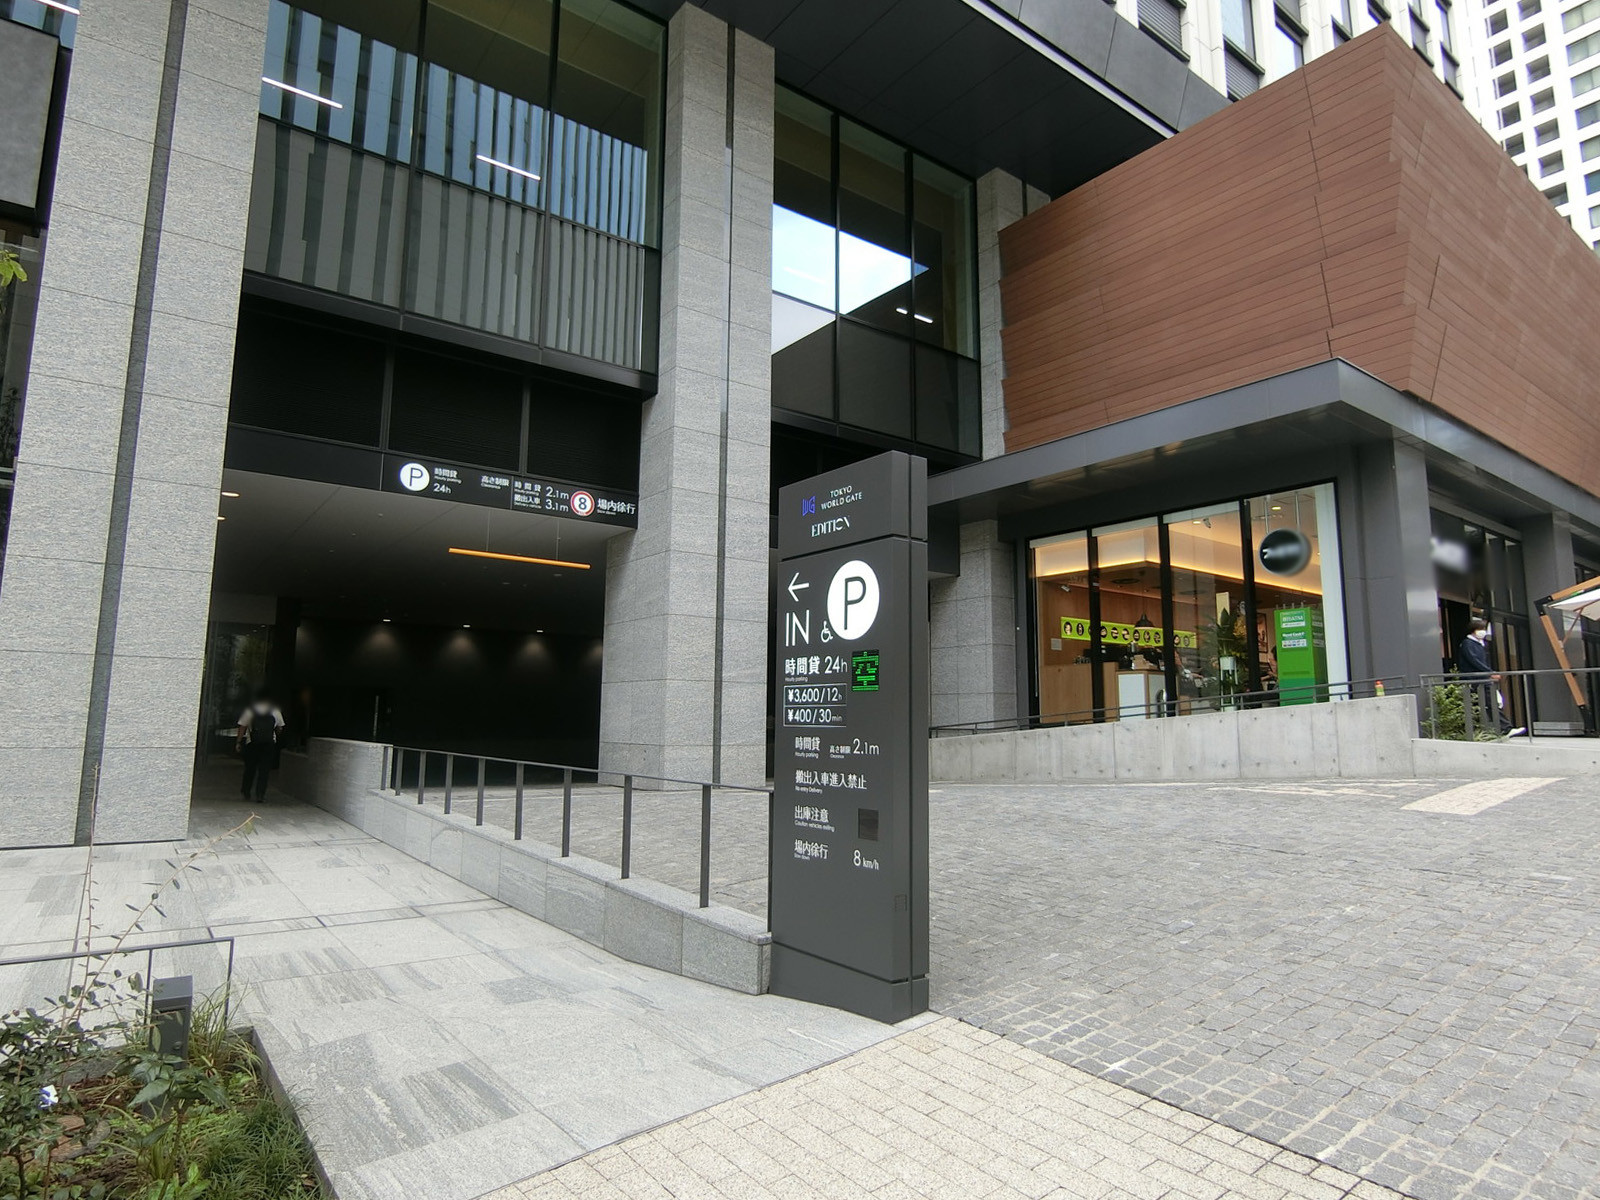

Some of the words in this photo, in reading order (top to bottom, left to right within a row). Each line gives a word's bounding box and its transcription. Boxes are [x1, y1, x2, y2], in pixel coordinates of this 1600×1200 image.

[409, 467, 424, 487] P
[433, 483, 452, 494] 24h
[545, 486, 569, 500] 2.1m
[829, 485, 852, 498] TOKYO
[545, 499, 569, 512] 3.1m
[578, 496, 588, 511] 8
[597, 498, 636, 515] 場内徐行
[821, 497, 845, 511] WORLD
[845, 492, 863, 504] GATE
[843, 575, 867, 631] P
[785, 609, 810, 647] IN
[785, 655, 820, 676] 時間貸
[824, 655, 847, 675] 24h
[852, 651, 879, 691] 空
[795, 736, 820, 751] 時間貸
[853, 738, 880, 756] 2.1m
[795, 769, 867, 790] 搬出入車進入禁止
[794, 805, 829, 823] 出庫注意
[794, 839, 829, 860] 場内徐行
[853, 849, 861, 867] 8
[863, 858, 879, 870] km/h
